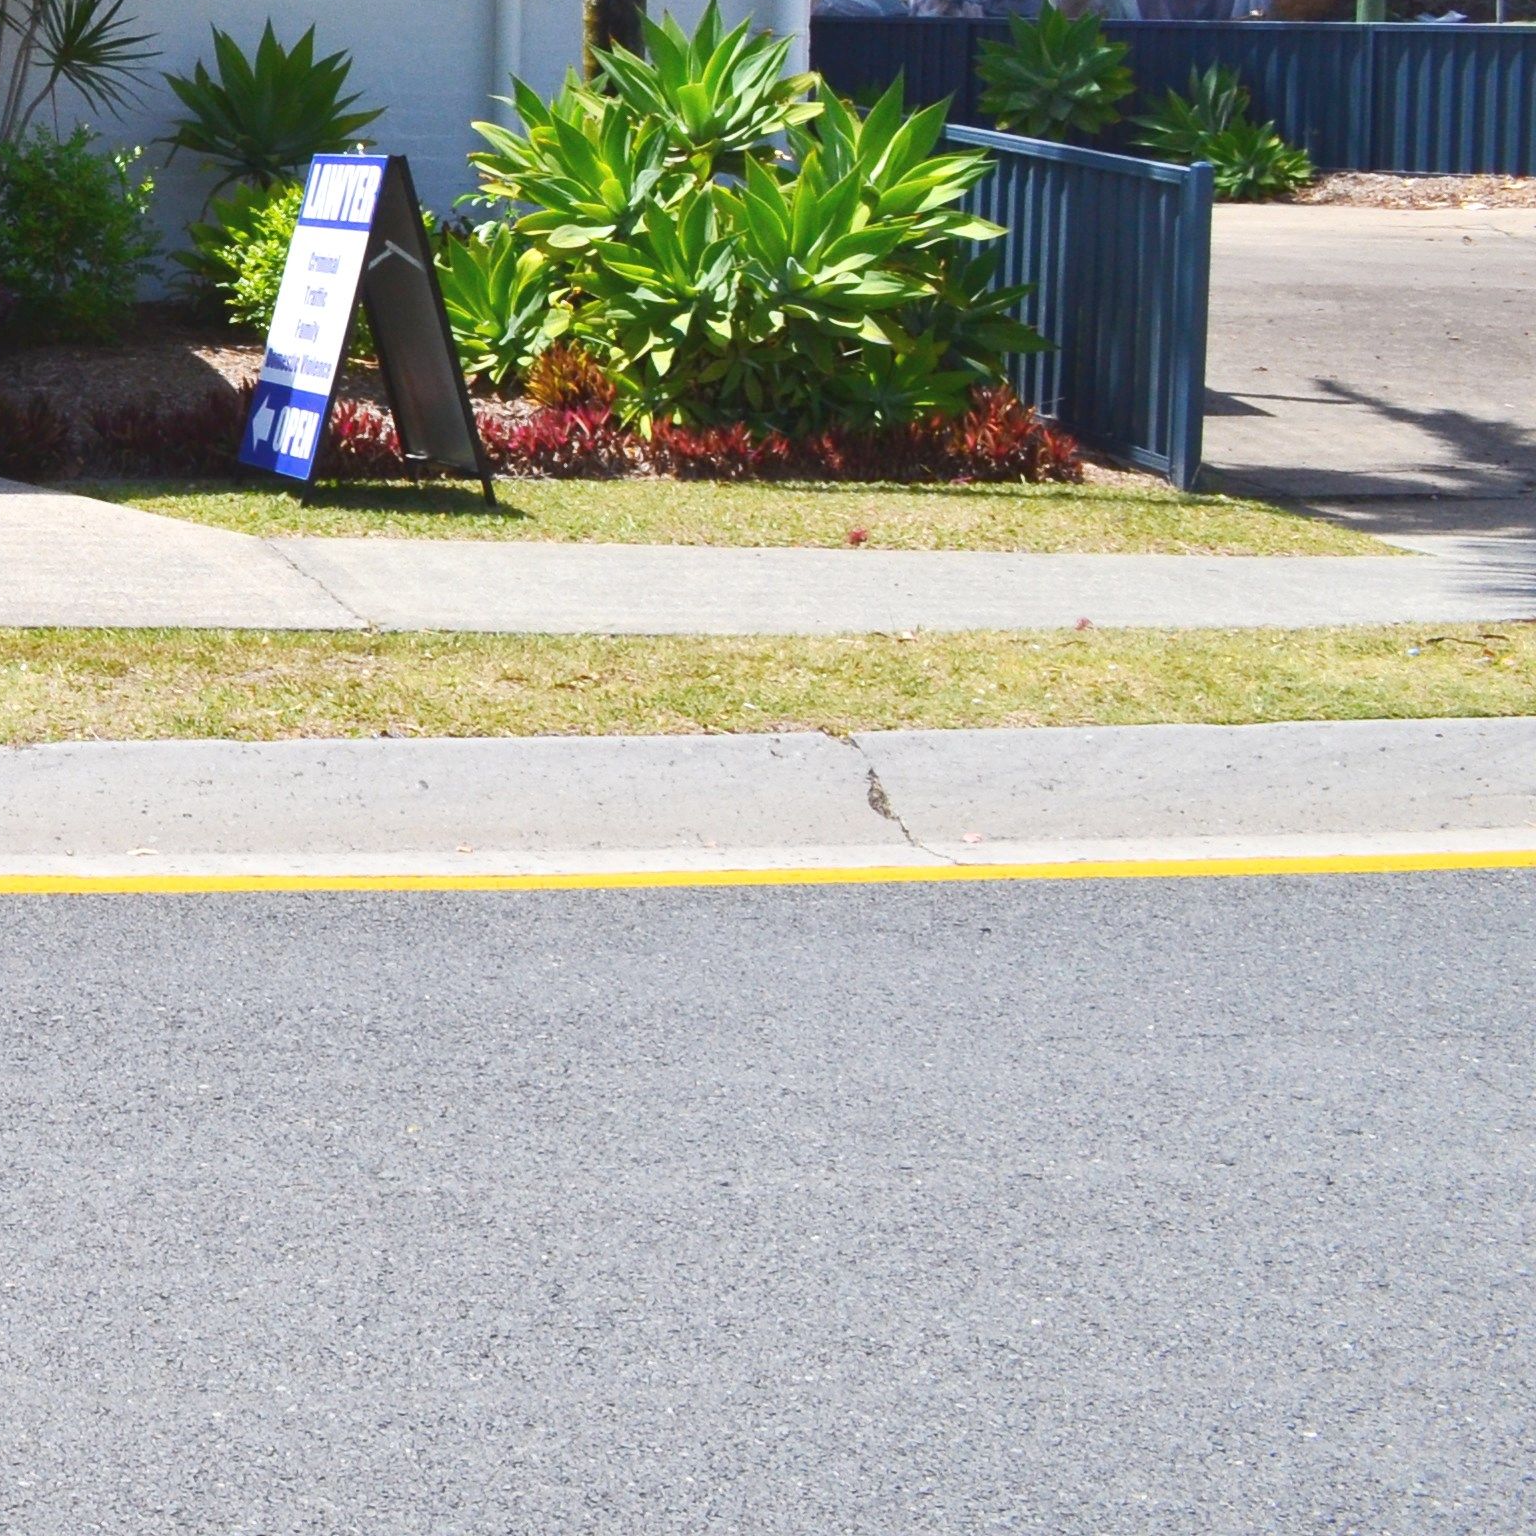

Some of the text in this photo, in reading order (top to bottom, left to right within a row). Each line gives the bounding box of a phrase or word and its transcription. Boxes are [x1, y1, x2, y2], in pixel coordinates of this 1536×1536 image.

[302, 163, 382, 223] LAWYER
[308, 251, 341, 274] Criminal
[304, 285, 328, 307] Traffic
[272, 406, 320, 459] OPEN
